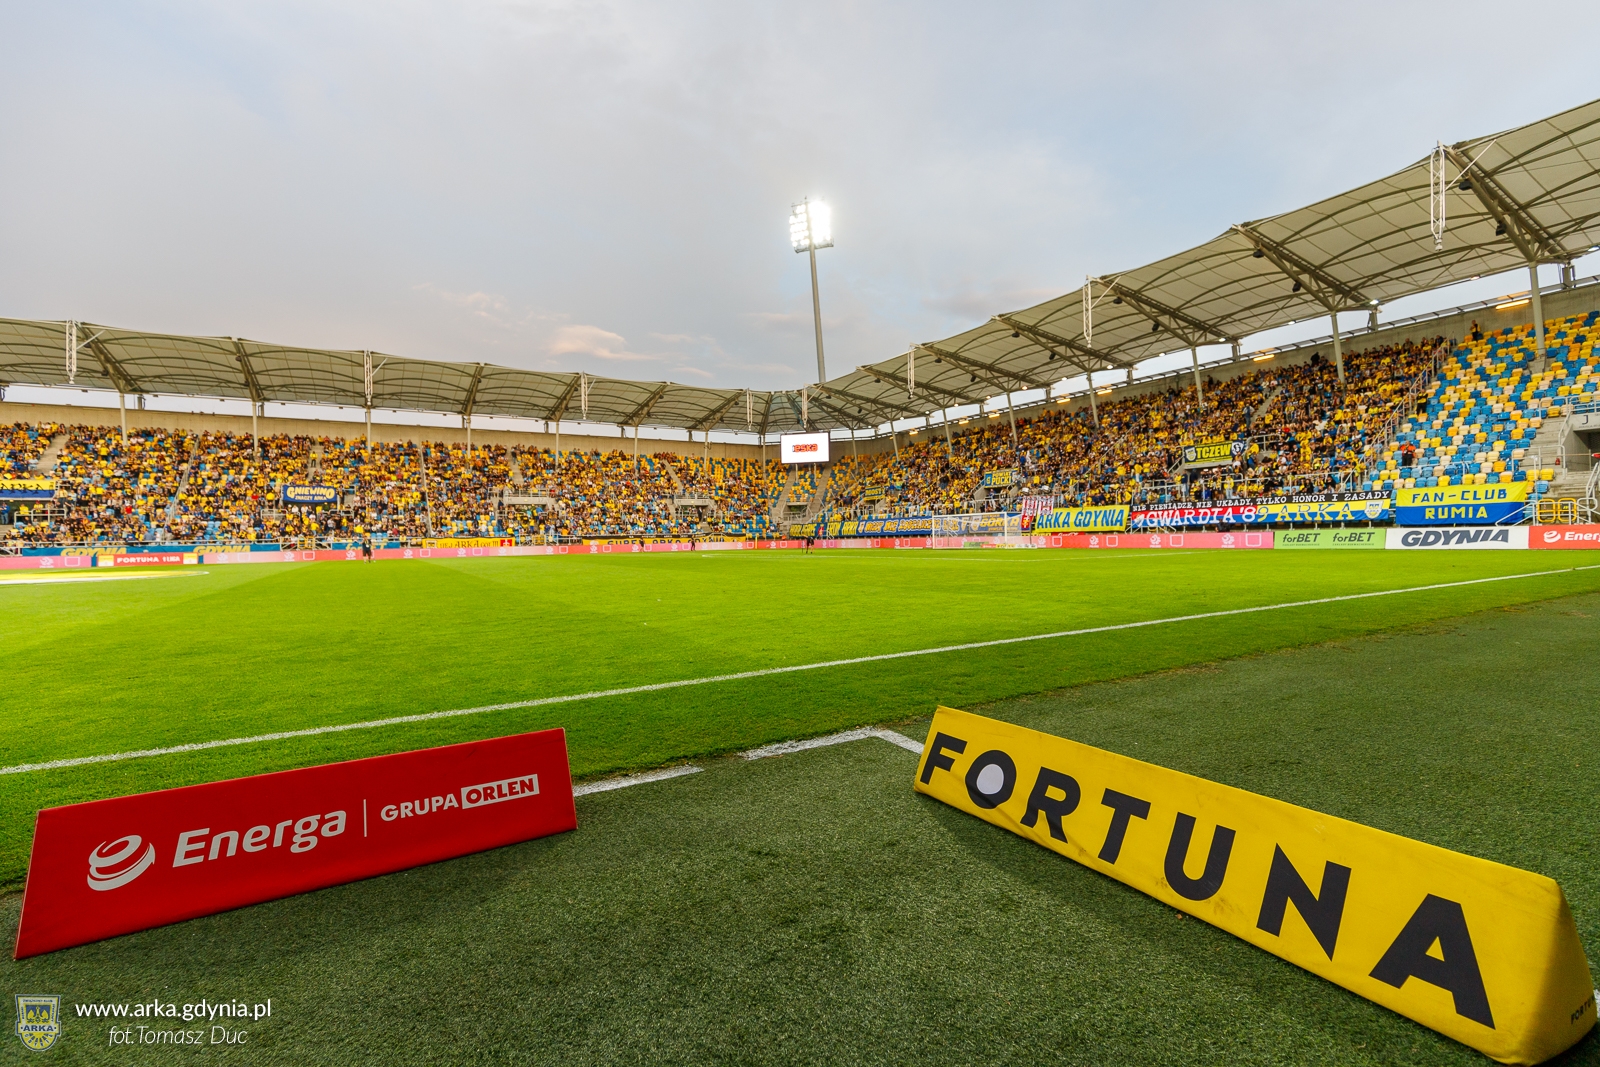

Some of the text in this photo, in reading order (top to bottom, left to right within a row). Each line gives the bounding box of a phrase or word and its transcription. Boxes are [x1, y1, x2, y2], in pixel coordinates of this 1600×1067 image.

[1196, 443, 1232, 459] TCZEW
[286, 486, 335, 499] GNIEWINO
[1196, 501, 1212, 509] NIE
[1256, 496, 1287, 505] TYLKO
[1292, 494, 1326, 503] HONOR
[1344, 490, 1390, 501] ZASADY
[1037, 509, 1125, 529] ARKA GDYNIA
[1146, 507, 1237, 527] GWARDIA
[1275, 502, 1355, 522] ARKA
[1425, 506, 1488, 520] RUMIA
[1283, 533, 1321, 543] forBET
[1333, 532, 1375, 543] forBET
[1401, 529, 1509, 547] GDYNIA
[380, 777, 535, 822] GRUPA ORLEN
[172, 810, 347, 868] Energa
[920, 732, 1495, 1030] FORTUNA
